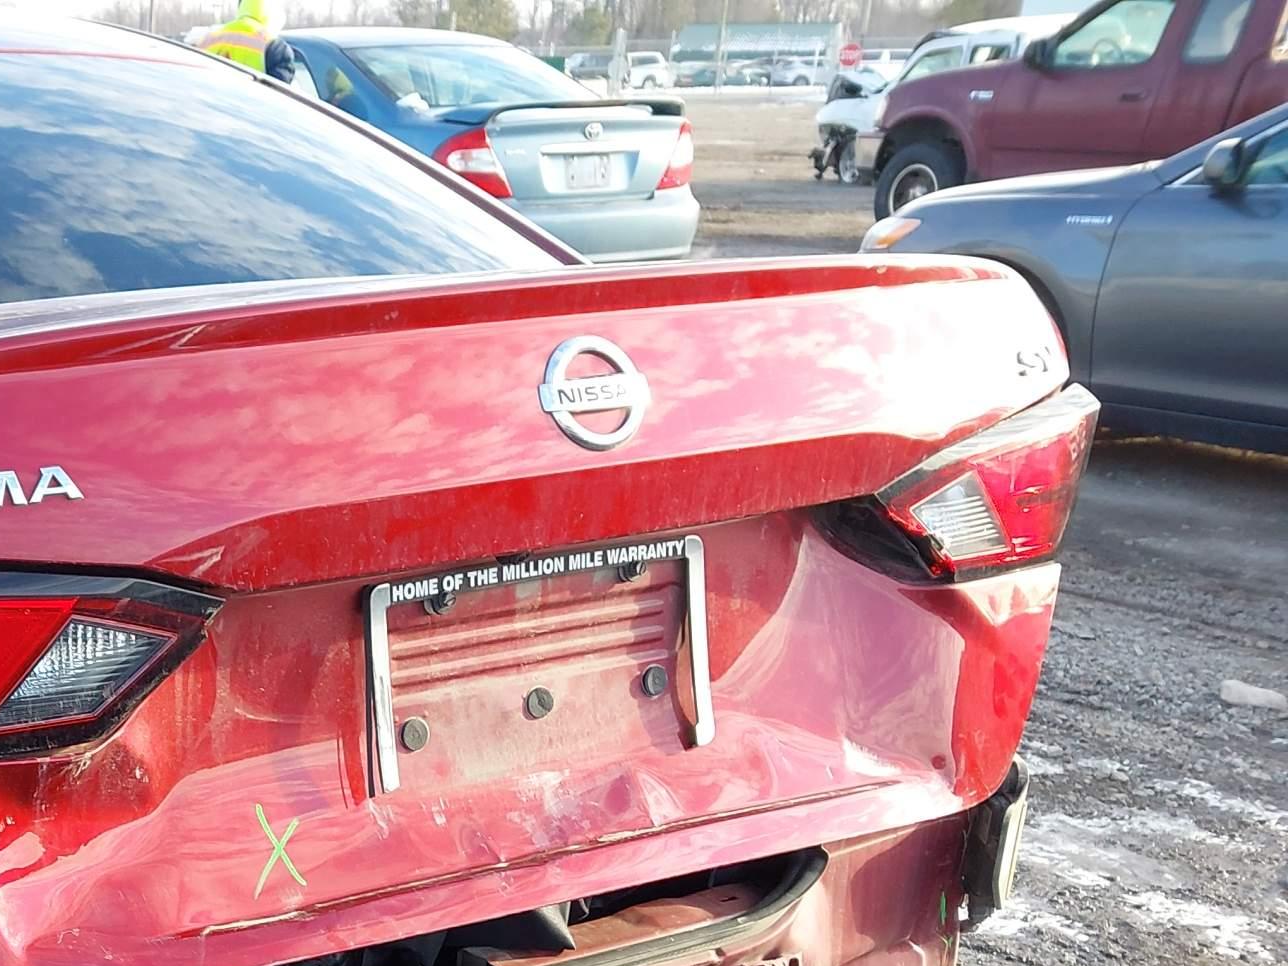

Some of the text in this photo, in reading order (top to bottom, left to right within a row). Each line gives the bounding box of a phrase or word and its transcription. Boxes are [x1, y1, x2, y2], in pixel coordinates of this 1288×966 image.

[556, 384, 626, 405] NISSA
[391, 539, 686, 603] HOME OF THE MILLION MILE WARRANTY
